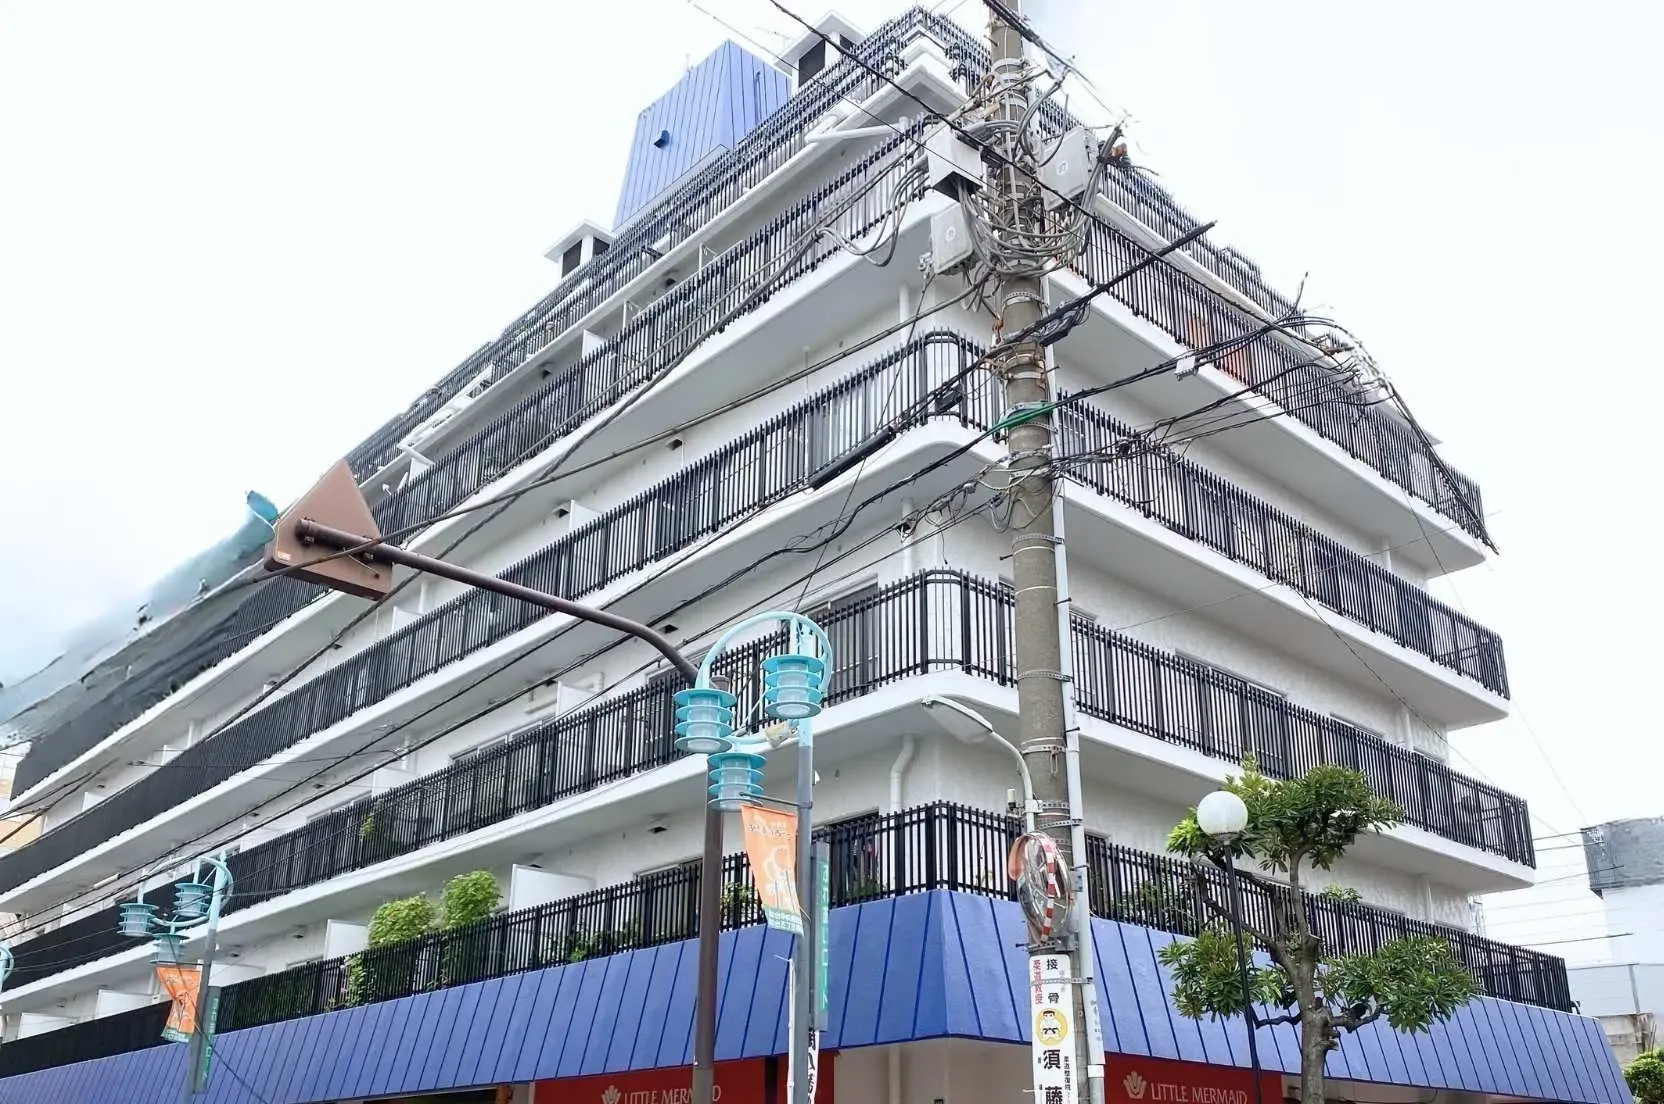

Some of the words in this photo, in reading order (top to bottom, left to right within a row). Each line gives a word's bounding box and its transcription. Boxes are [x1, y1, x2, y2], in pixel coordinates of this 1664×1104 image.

[625, 1090, 657, 1104] LITTLE
[1151, 1083, 1188, 1102] LITTLE
[1192, 1087, 1248, 1104] MERMAID
